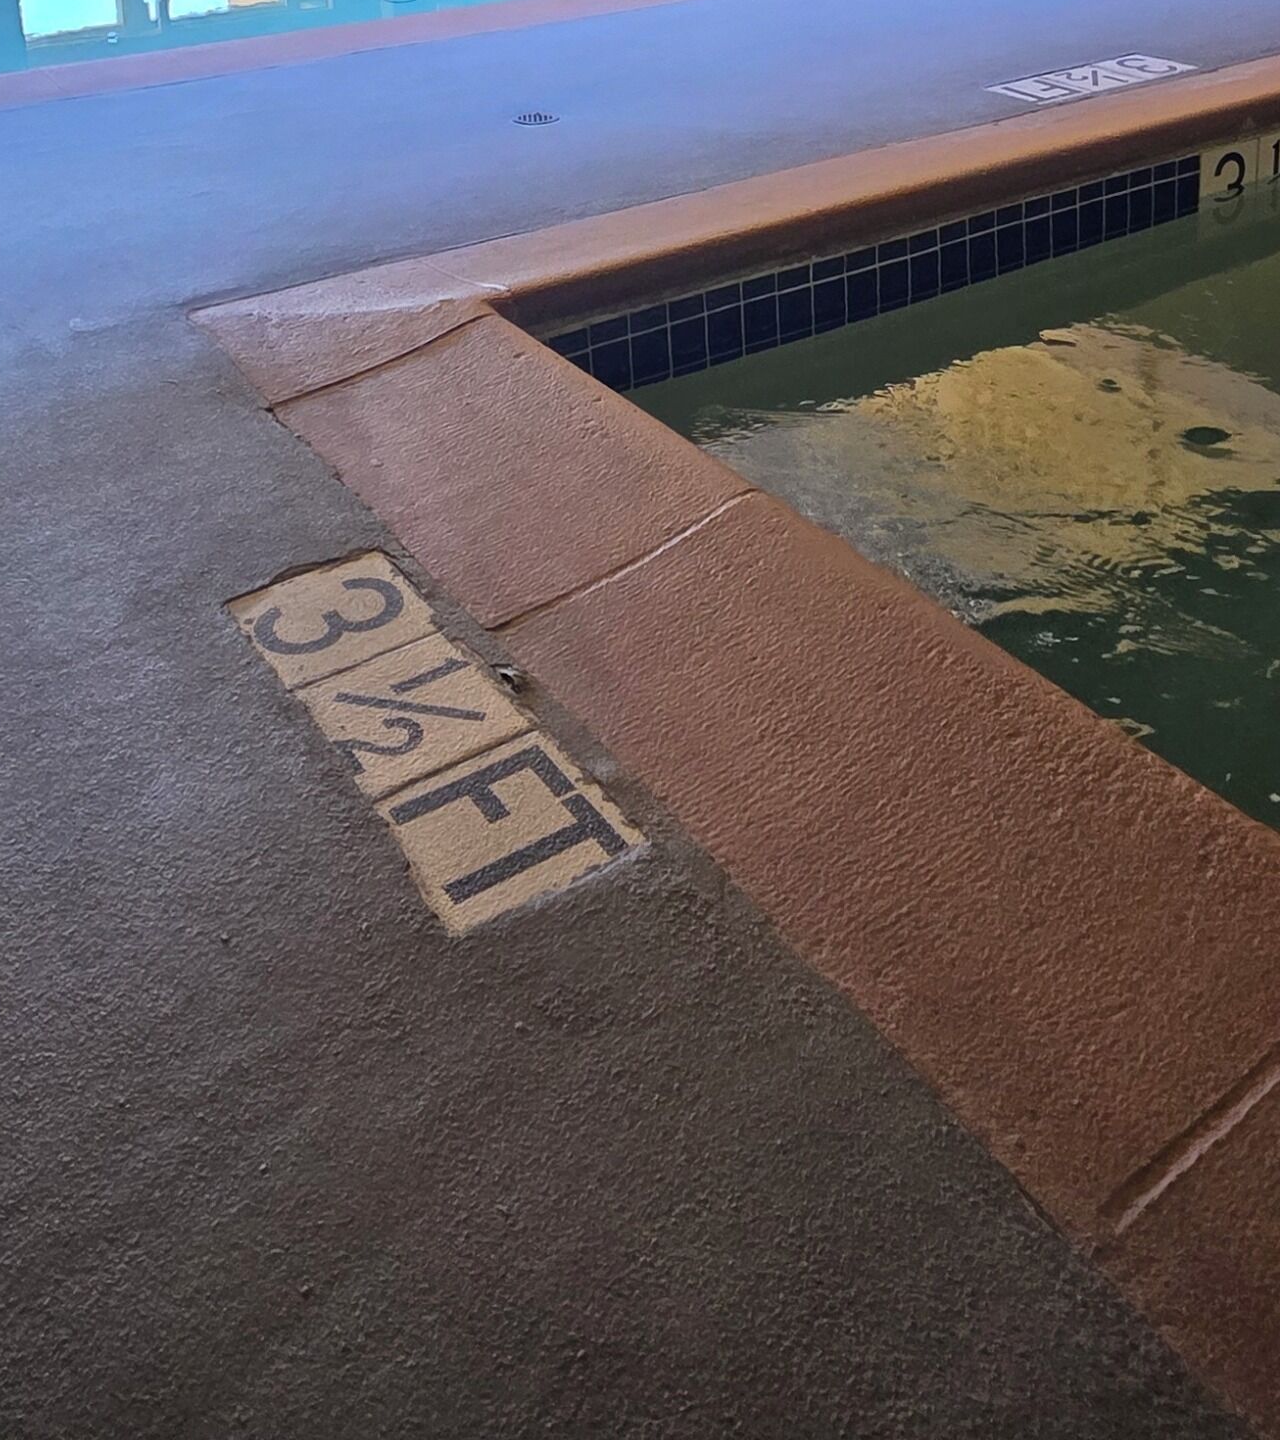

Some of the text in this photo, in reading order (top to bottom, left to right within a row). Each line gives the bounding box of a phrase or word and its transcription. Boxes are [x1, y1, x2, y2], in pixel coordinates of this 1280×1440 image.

[1116, 57, 1178, 74] 3
[1001, 78, 1083, 103] FT
[1213, 151, 1246, 202] 3
[251, 576, 405, 655] 3
[388, 744, 629, 905] FT
